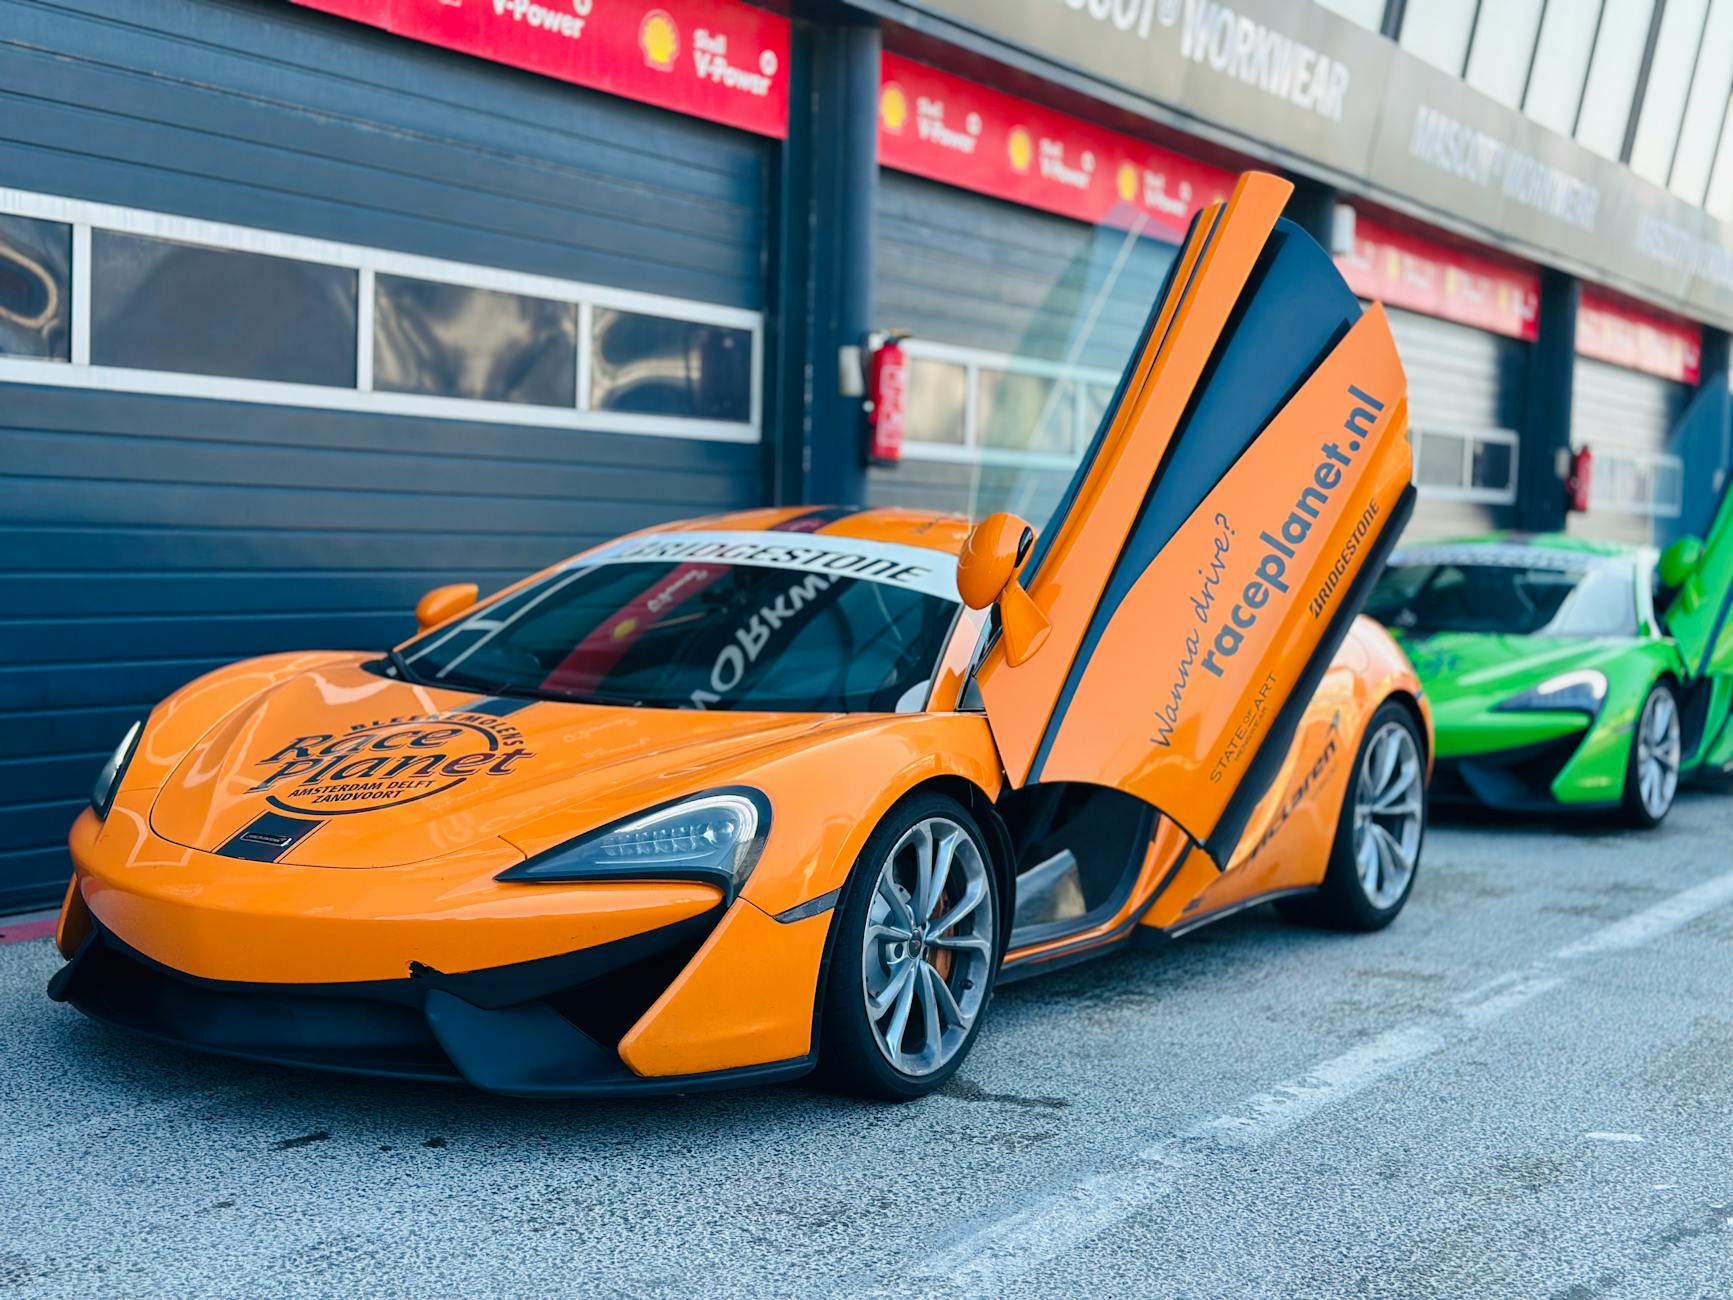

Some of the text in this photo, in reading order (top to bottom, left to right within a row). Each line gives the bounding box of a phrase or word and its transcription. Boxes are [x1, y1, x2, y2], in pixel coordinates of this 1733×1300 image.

[1180, 0, 1350, 121] WORKWEAR
[620, 541, 931, 583] BRIDGESTONE
[1200, 384, 1385, 678] raceplanet.nl
[1309, 499, 1380, 618] BRIDGESTONE
[1150, 512, 1236, 747] Wanna drive?
[255, 728, 464, 766] Race
[1209, 724, 1249, 784] STATE
[1253, 672, 1278, 711] ART
[242, 748, 537, 795] Planet
[288, 779, 437, 798] AMSTERDAM DELFT
[311, 790, 403, 804] ZANDVOORT
